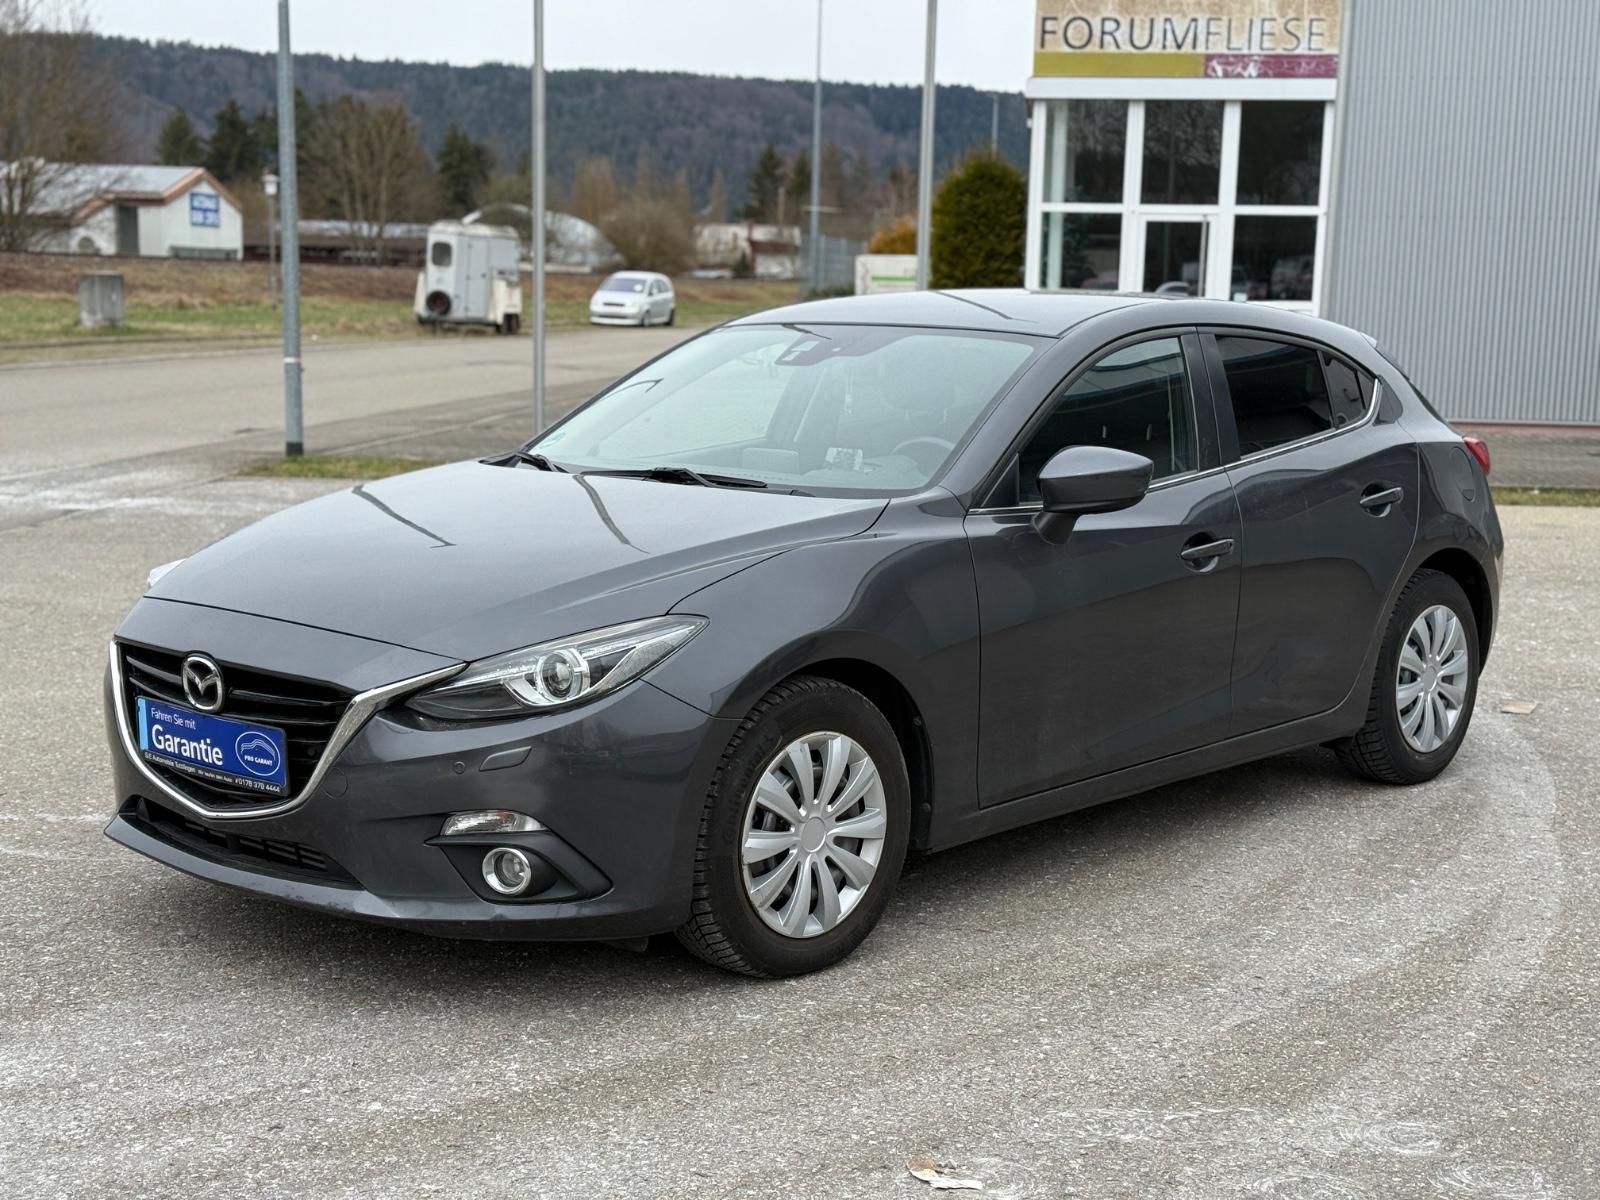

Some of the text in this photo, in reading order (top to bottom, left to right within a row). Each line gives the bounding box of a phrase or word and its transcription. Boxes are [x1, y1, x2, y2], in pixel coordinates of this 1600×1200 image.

[151, 708, 197, 730] Fahren Sie mit
[152, 724, 223, 765] Garantie
[254, 757, 273, 766] GARANT
[265, 784, 280, 792] 4444
